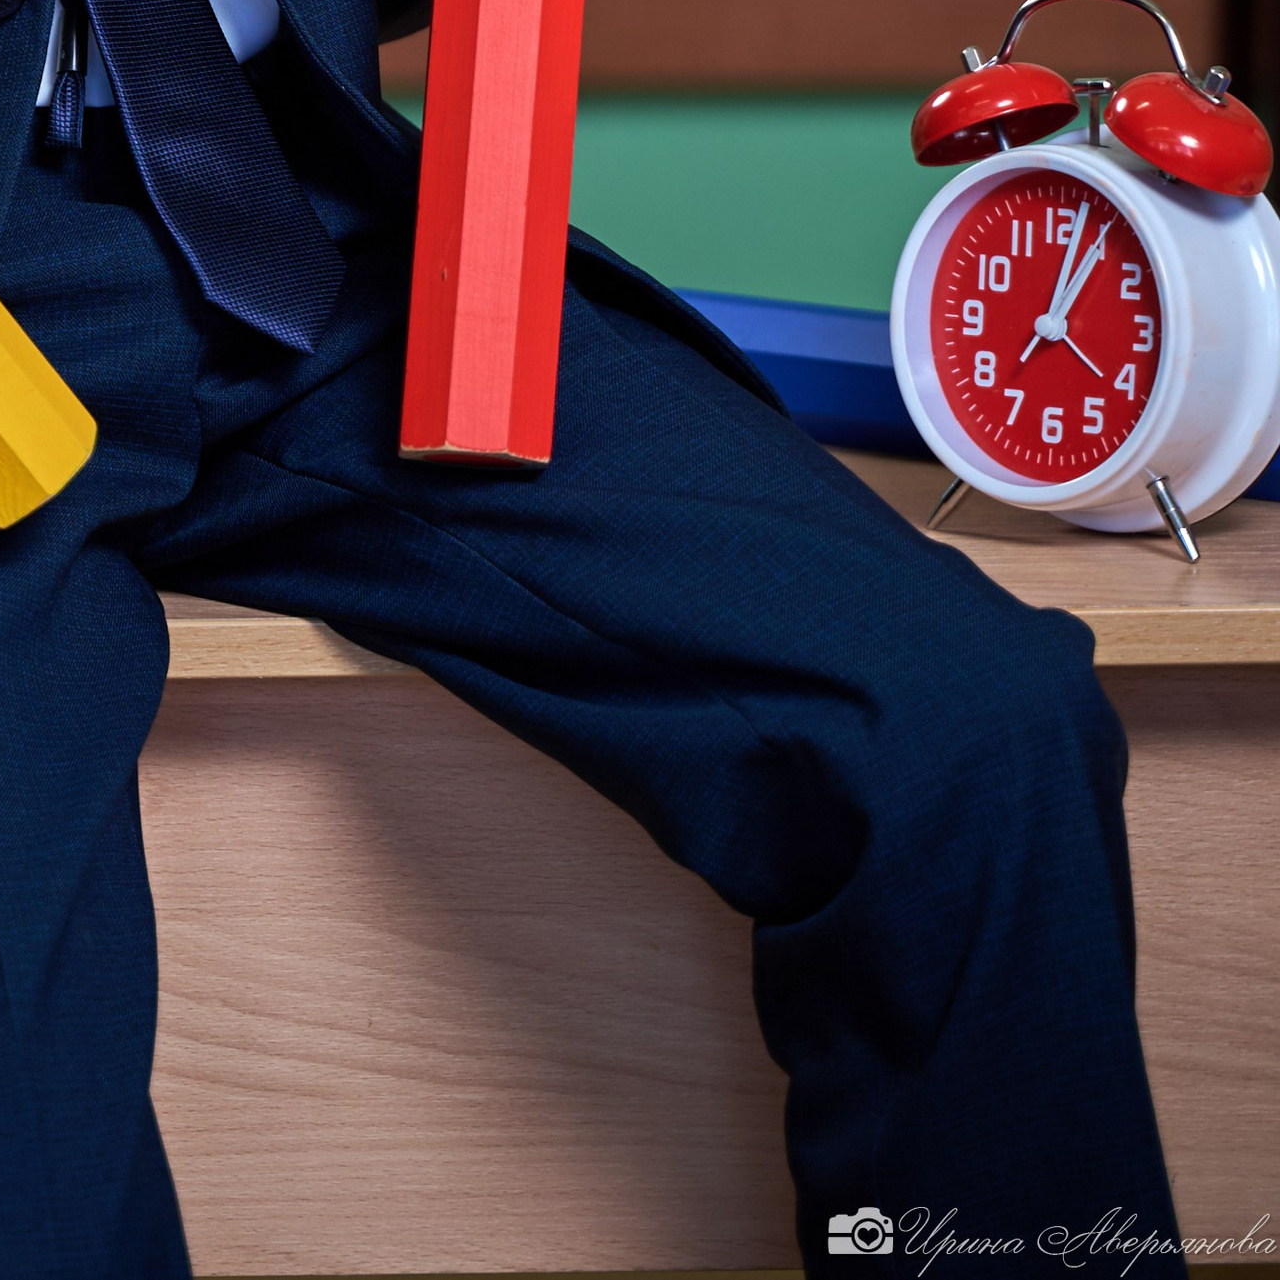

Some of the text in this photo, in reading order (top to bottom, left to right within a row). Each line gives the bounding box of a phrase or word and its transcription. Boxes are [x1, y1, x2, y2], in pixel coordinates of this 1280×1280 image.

[1012, 219, 1033, 257] 11
[1046, 207, 1078, 245] 12
[978, 254, 1011, 292] 10
[1120, 263, 1142, 300] 2
[962, 299, 984, 336] 9
[1132, 315, 1154, 352] 3
[974, 350, 996, 388] 8
[1114, 363, 1136, 401] 4
[1004, 388, 1024, 426] 7
[1041, 406, 1064, 444] 6
[1082, 396, 1105, 435] 5
